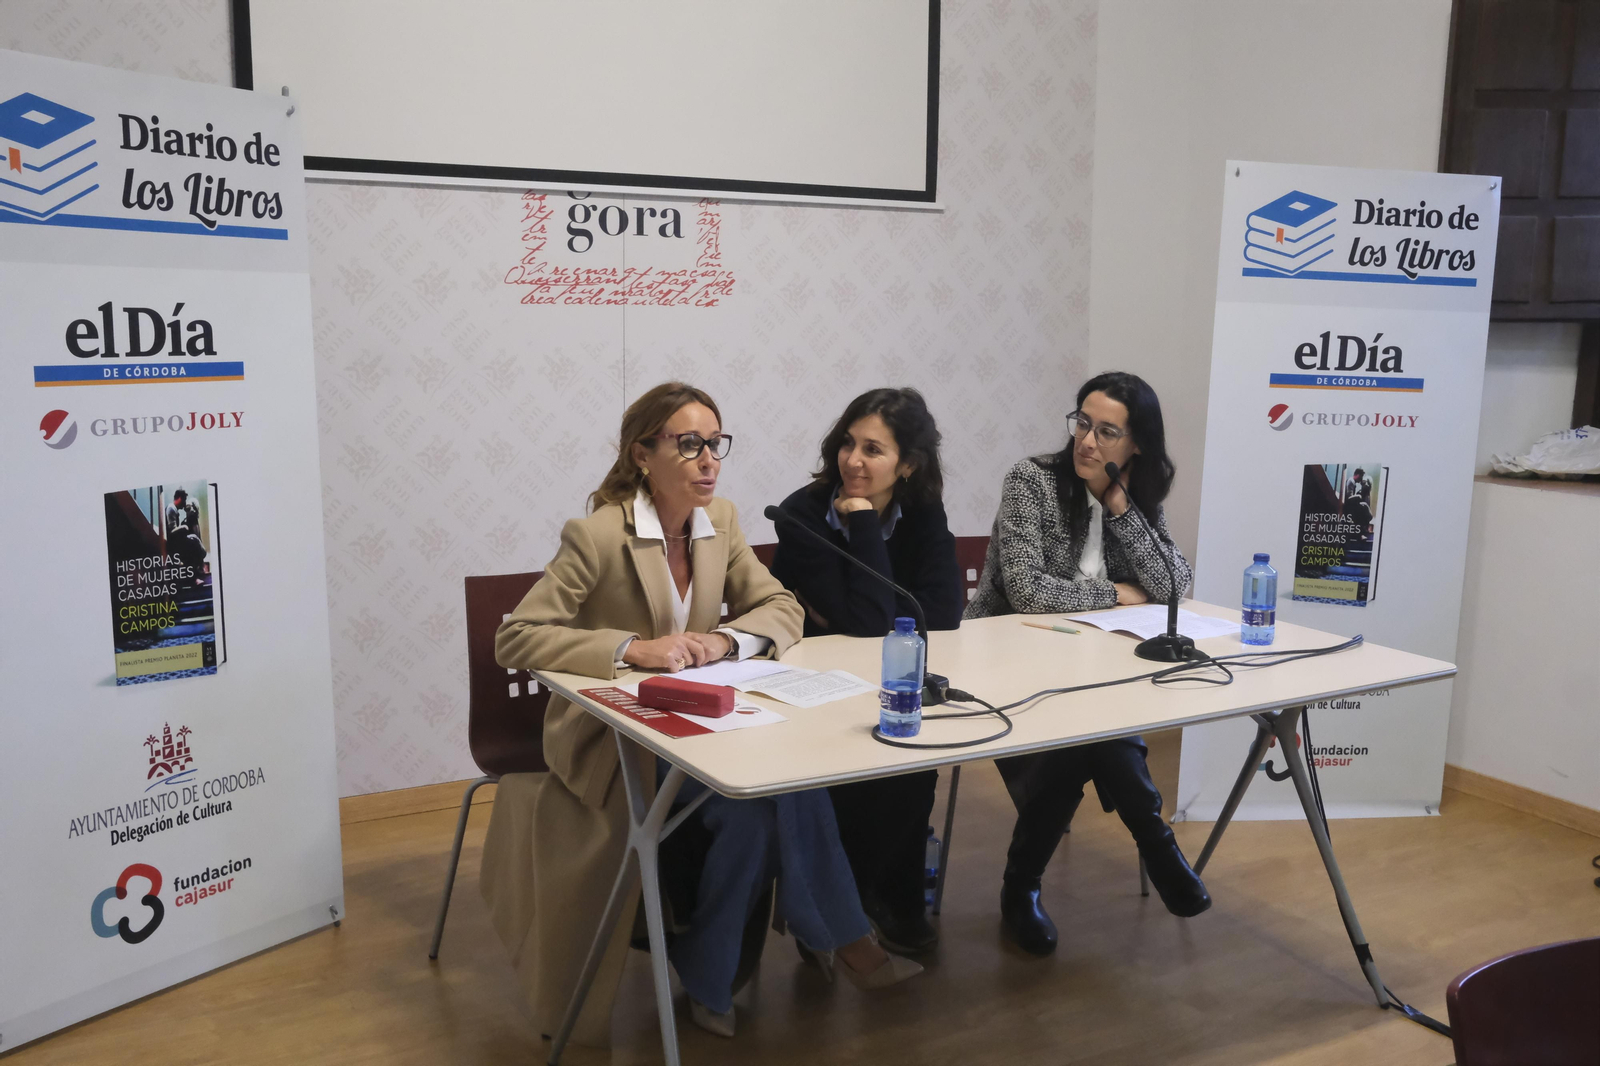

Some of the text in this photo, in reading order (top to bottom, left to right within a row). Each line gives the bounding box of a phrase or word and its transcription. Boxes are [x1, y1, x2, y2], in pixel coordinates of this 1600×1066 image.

[118, 113, 280, 166] Diario de
[122, 168, 174, 211] los
[183, 172, 283, 229] Libros
[1353, 198, 1480, 230] Diario de
[566, 203, 685, 253] gora
[1348, 237, 1476, 279] los Libros
[103, 364, 187, 378] DE CÓRDOBA
[1316, 377, 1378, 387] DE CÓRDOBA
[1304, 513, 1352, 523] HISTORIAS
[1304, 523, 1361, 534] DE MUJERES
[1303, 534, 1346, 544] CASADAS
[1302, 546, 1345, 557] CRISTINA
[116, 553, 181, 573] HISTORIAS
[1301, 556, 1341, 567] CAMPOS
[117, 566, 194, 587] DE MUJERES
[118, 583, 178, 602] CASADAS
[119, 601, 179, 619] CRISTINA
[120, 617, 175, 634] CAMPOS
[119, 658, 144, 667] FINALISTA
[164, 653, 184, 661] PLANETA
[1330, 698, 1361, 709] Cultura
[1308, 756, 1353, 768] ajasur
[68, 767, 266, 839] AYUNTAMIENTO DE CORDOBA
[110, 800, 233, 846] Delegación de Cultura
[173, 857, 252, 892] fundacion
[175, 876, 235, 907] cajasur
